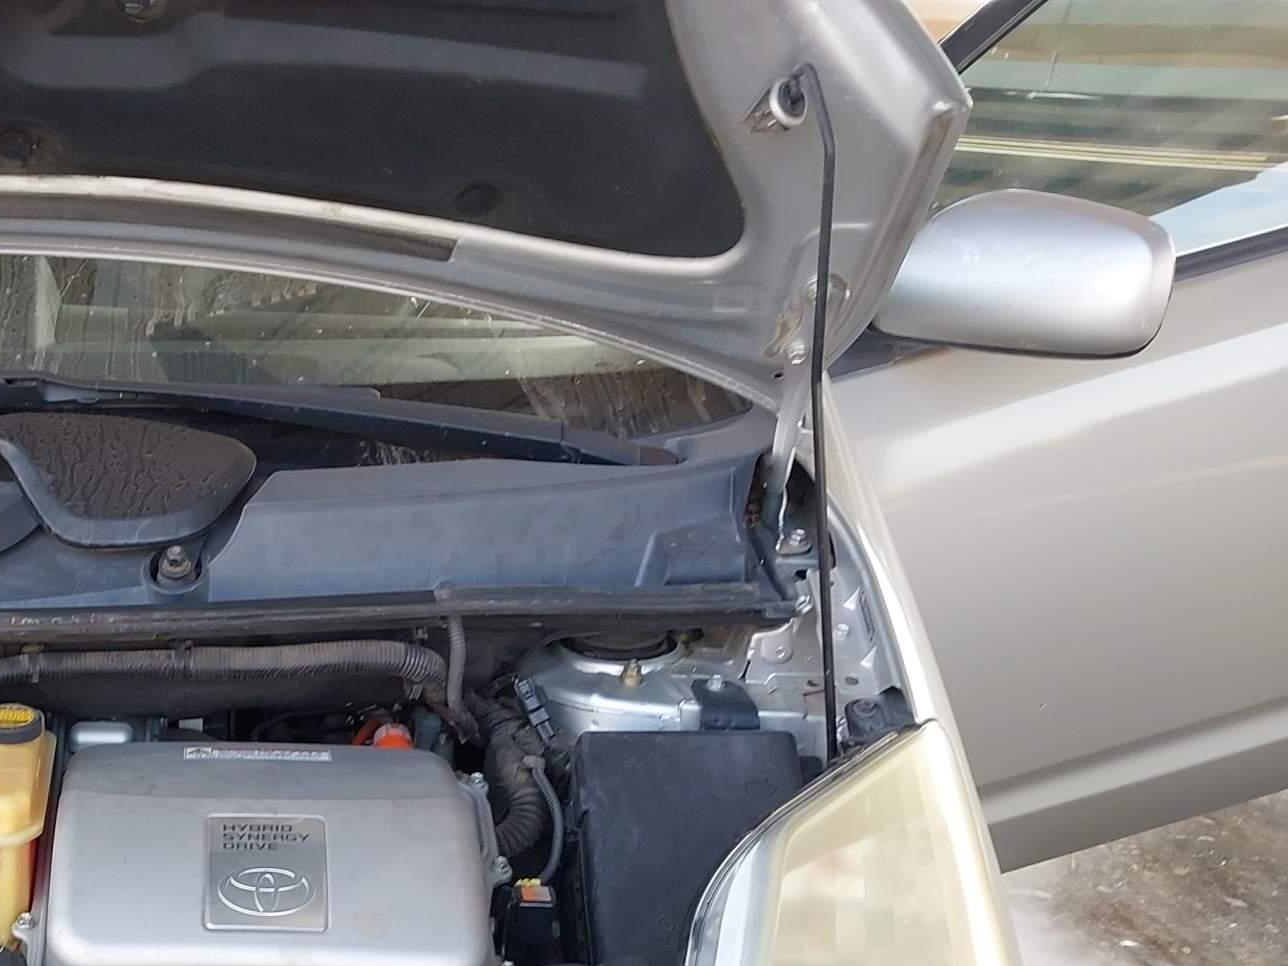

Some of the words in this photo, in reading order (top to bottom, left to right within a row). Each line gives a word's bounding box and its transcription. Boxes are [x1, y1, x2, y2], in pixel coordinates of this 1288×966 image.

[222, 823, 294, 833] HYBRID
[222, 833, 310, 842] SYNERGY
[222, 842, 279, 851] DRIVE
